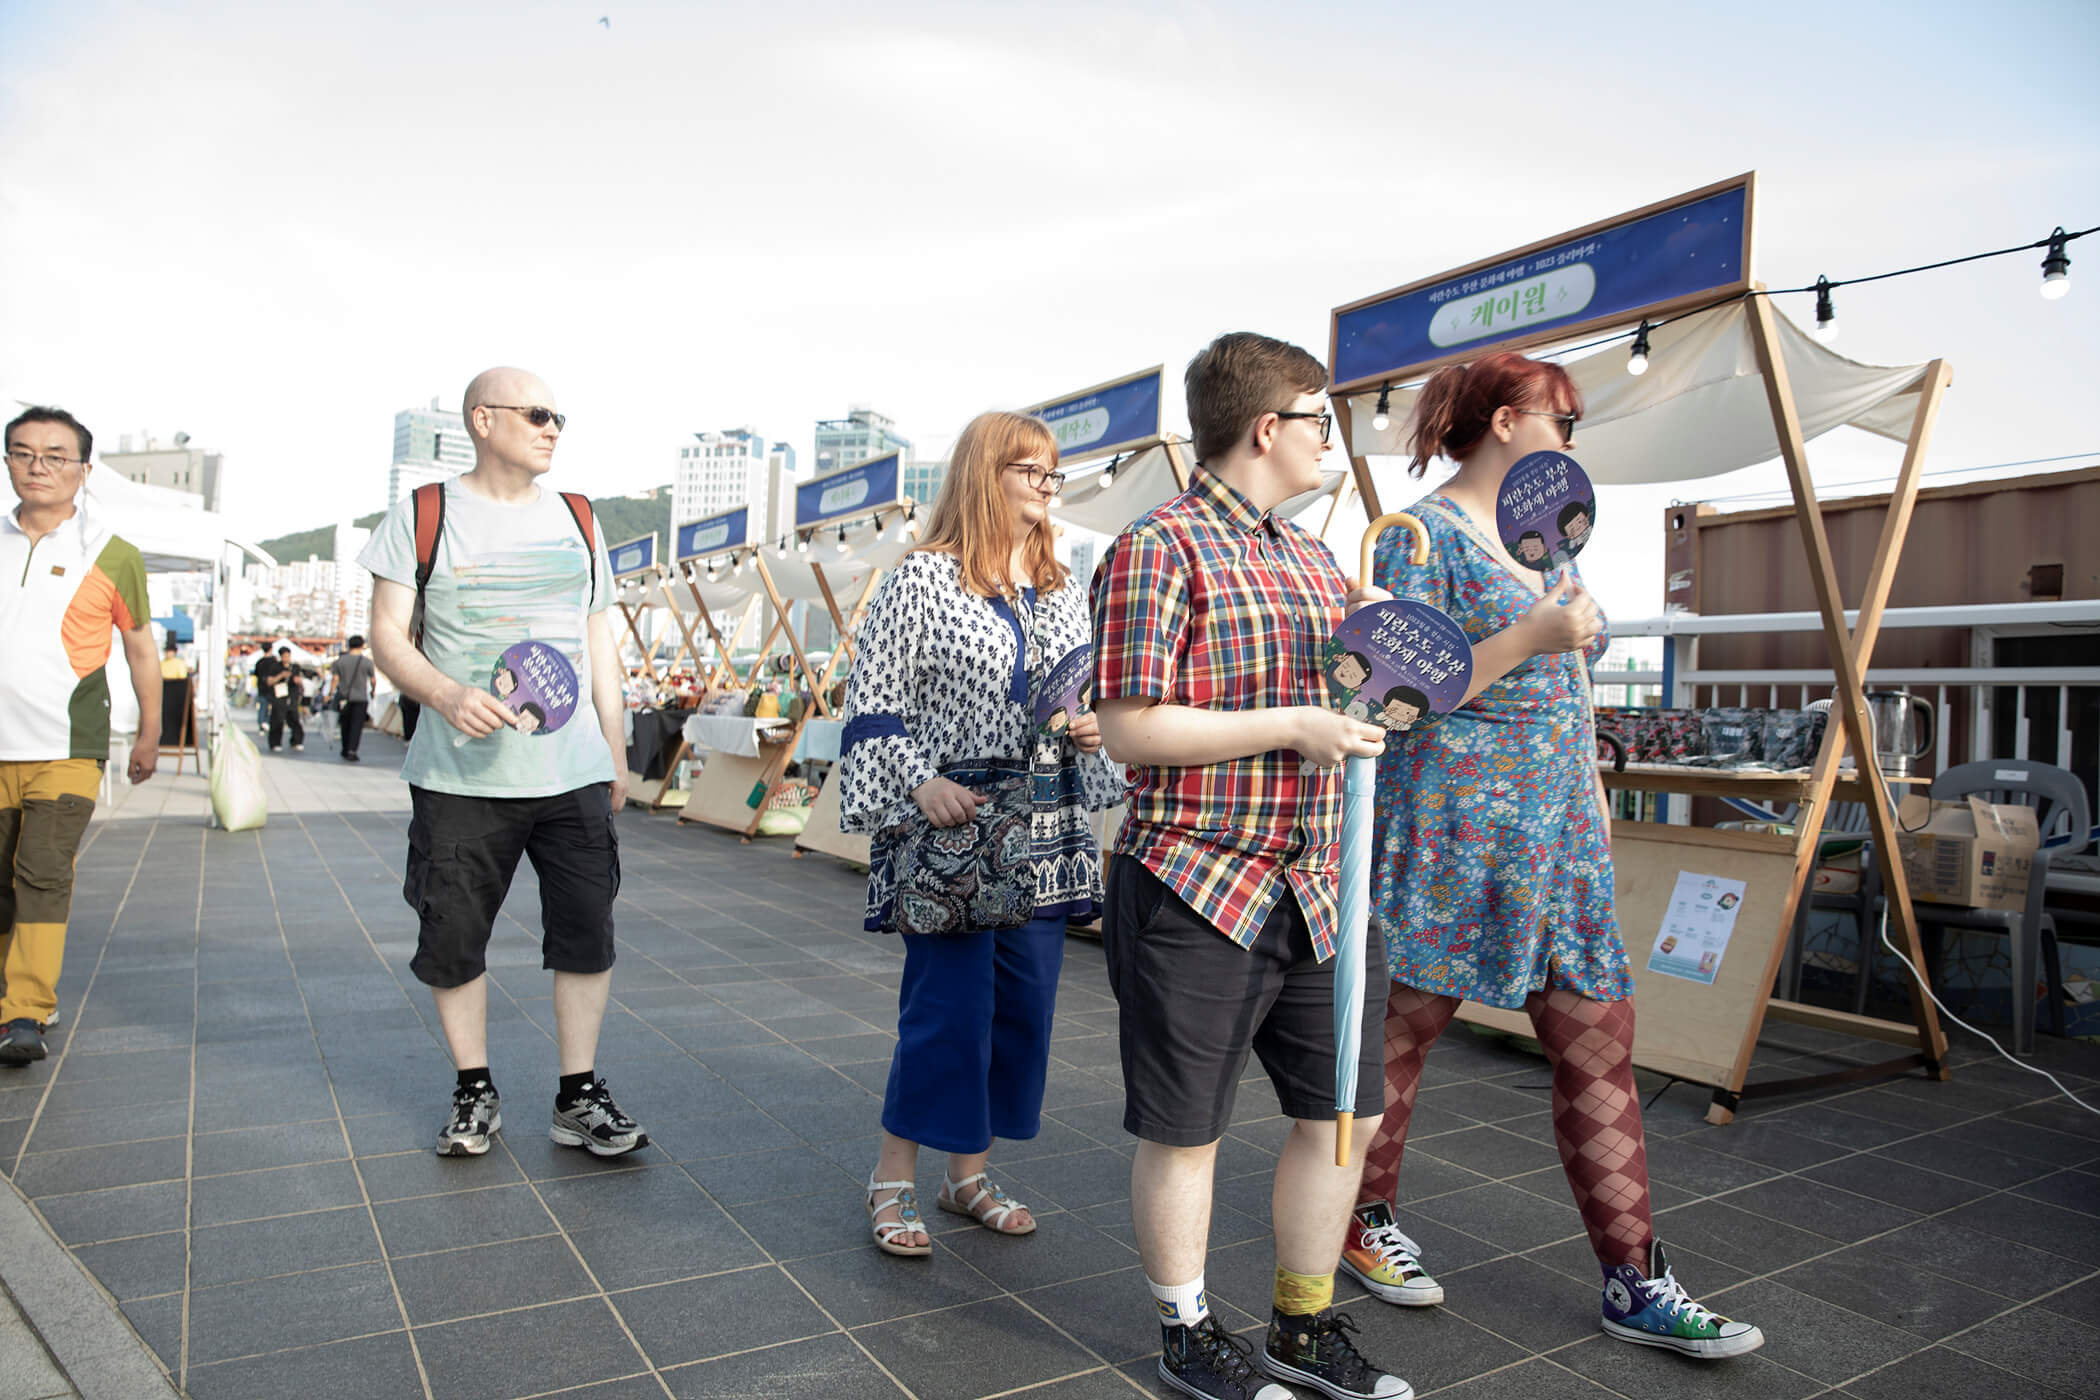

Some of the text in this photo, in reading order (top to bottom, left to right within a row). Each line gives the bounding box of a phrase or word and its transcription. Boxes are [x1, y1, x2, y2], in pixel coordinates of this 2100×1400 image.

[1535, 258, 1556, 271] 1023
[1470, 281, 1547, 327] 케이원
[1501, 477, 1545, 508] 피란수도
[1545, 459, 1569, 481] 부산
[1512, 491, 1545, 520] 문화재
[1545, 477, 1570, 498] 야행
[1370, 627, 1418, 665] 문화재
[1416, 658, 1449, 685] 야행
[1376, 607, 1435, 655] 피란수도
[1435, 649, 1467, 677] 부산
